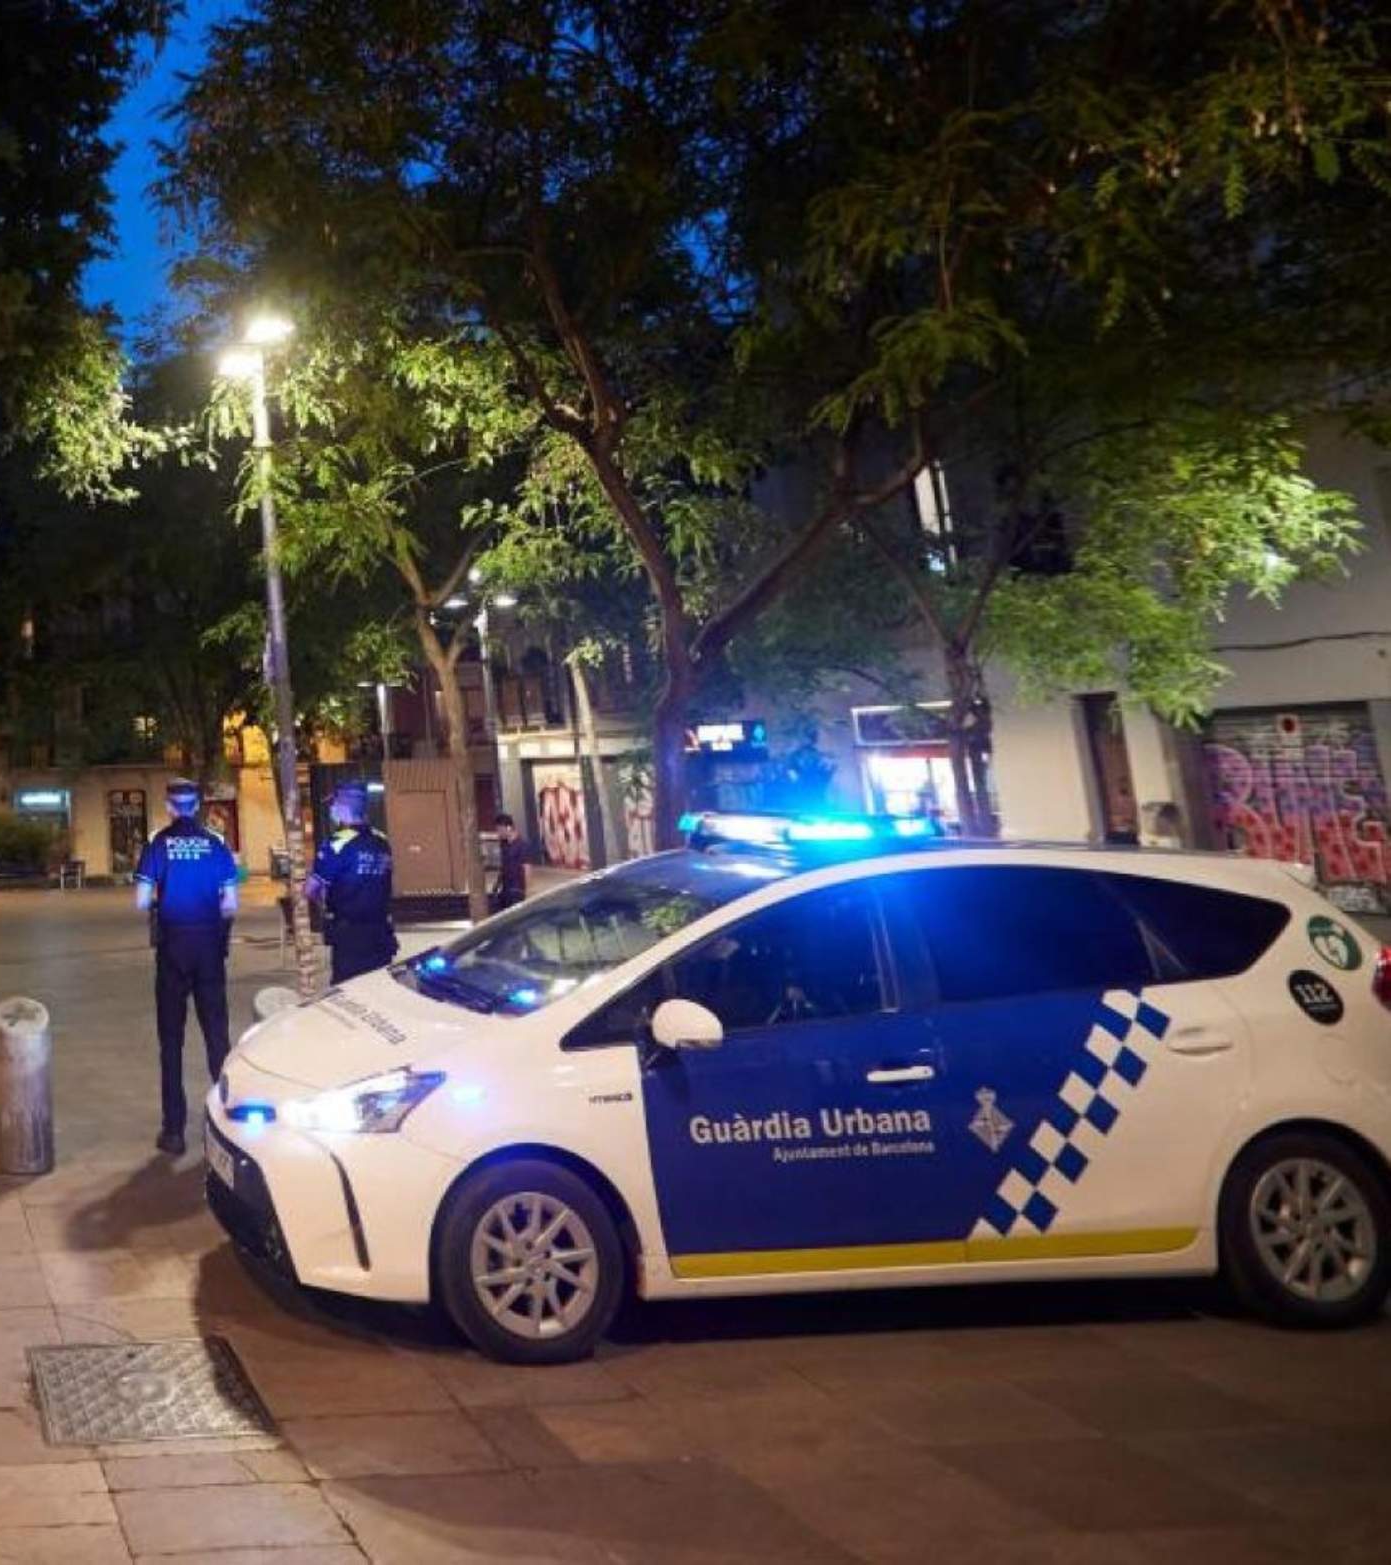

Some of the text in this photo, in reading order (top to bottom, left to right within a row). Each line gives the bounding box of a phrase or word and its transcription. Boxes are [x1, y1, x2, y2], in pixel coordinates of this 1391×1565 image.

[690, 1108, 931, 1144] Guàrdia Urbana
[773, 1141, 935, 1162] Ajuntament de Barcelona
